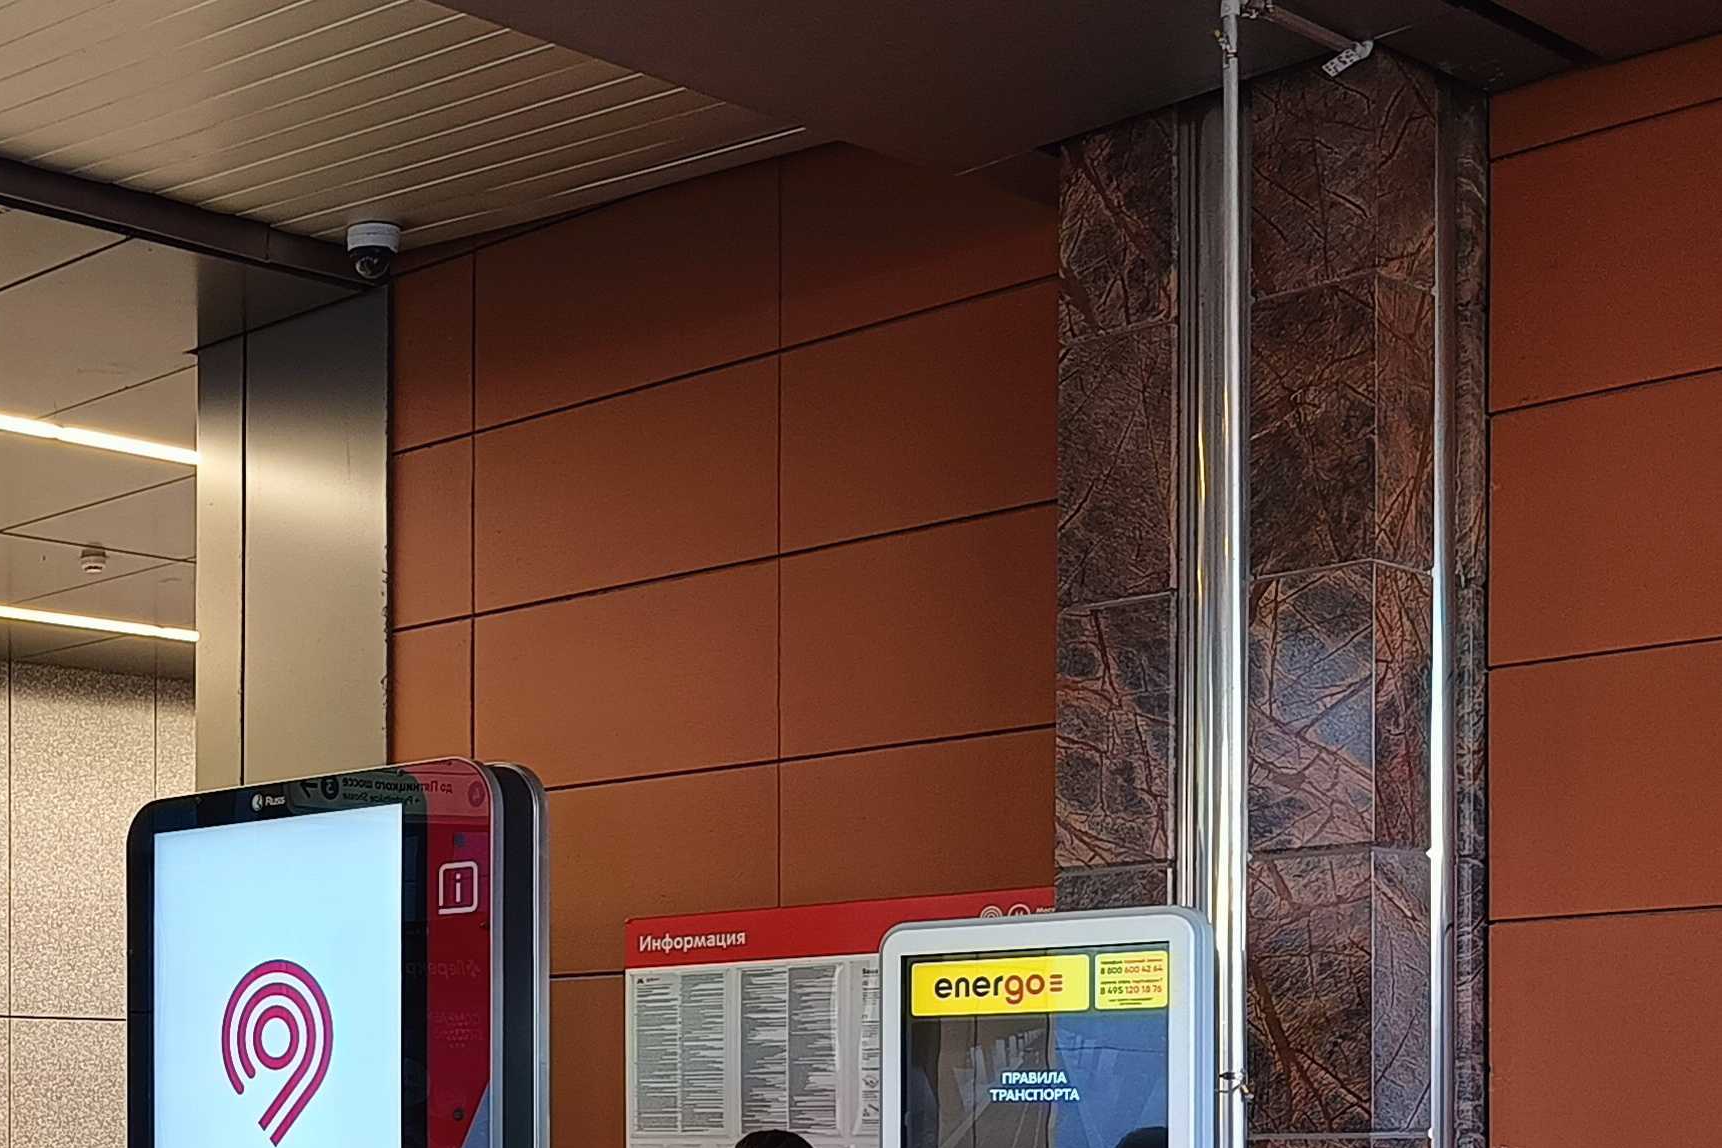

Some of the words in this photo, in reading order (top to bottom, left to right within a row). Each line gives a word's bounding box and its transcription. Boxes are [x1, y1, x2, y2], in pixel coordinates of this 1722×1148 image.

[639, 931, 746, 954] Информация
[934, 973, 1046, 1005] energo
[1002, 1072, 1067, 1085] ПРАВИЛА
[989, 1088, 1080, 1101] ТРАНСПОРТА
